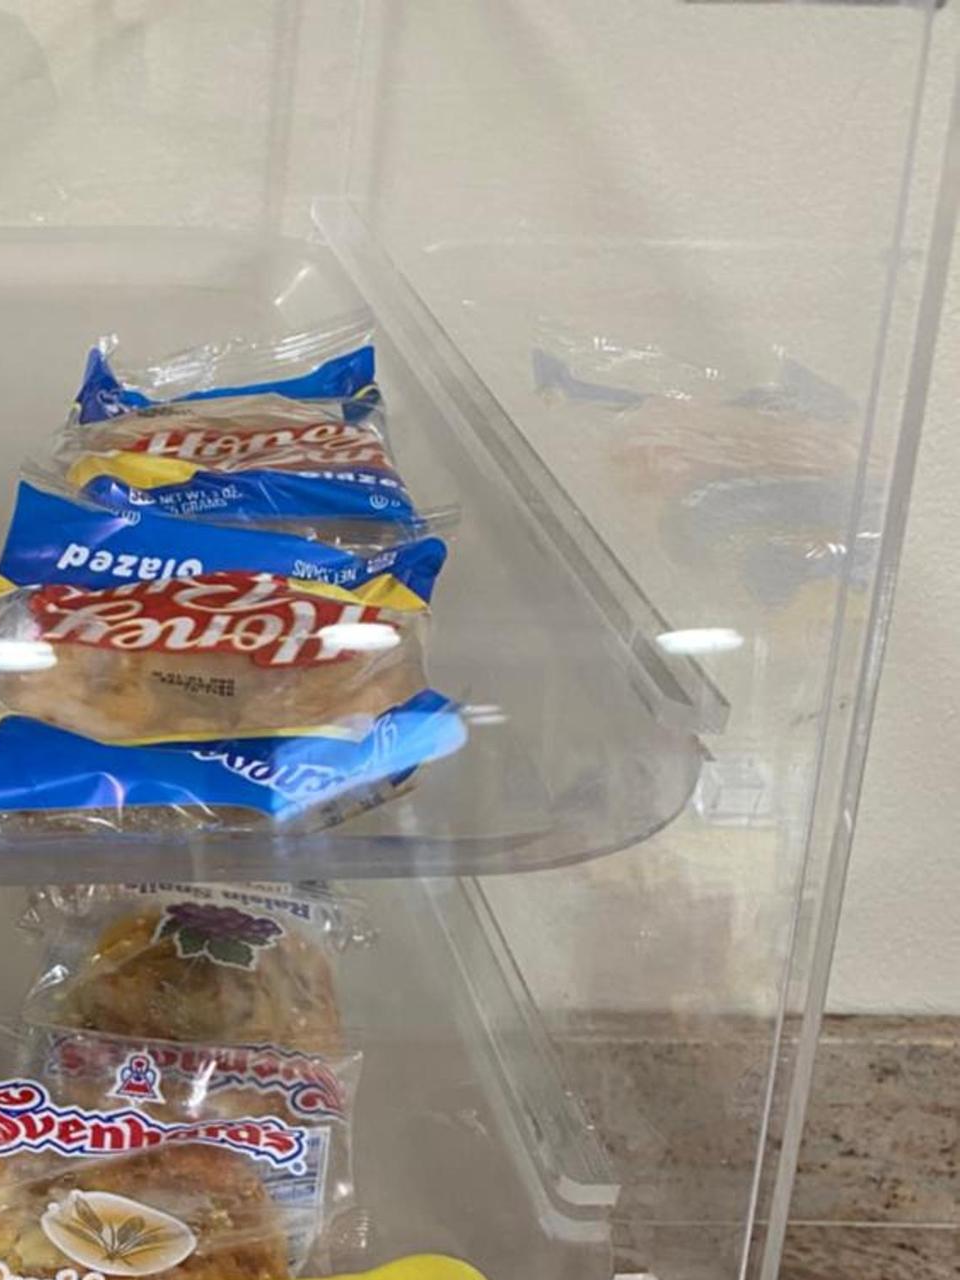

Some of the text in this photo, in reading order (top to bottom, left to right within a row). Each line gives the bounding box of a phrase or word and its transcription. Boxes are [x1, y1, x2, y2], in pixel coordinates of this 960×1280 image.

[56, 543, 203, 584] Glazed
[46, 600, 385, 665] Honey
[221, 890, 311, 919] Raisin
